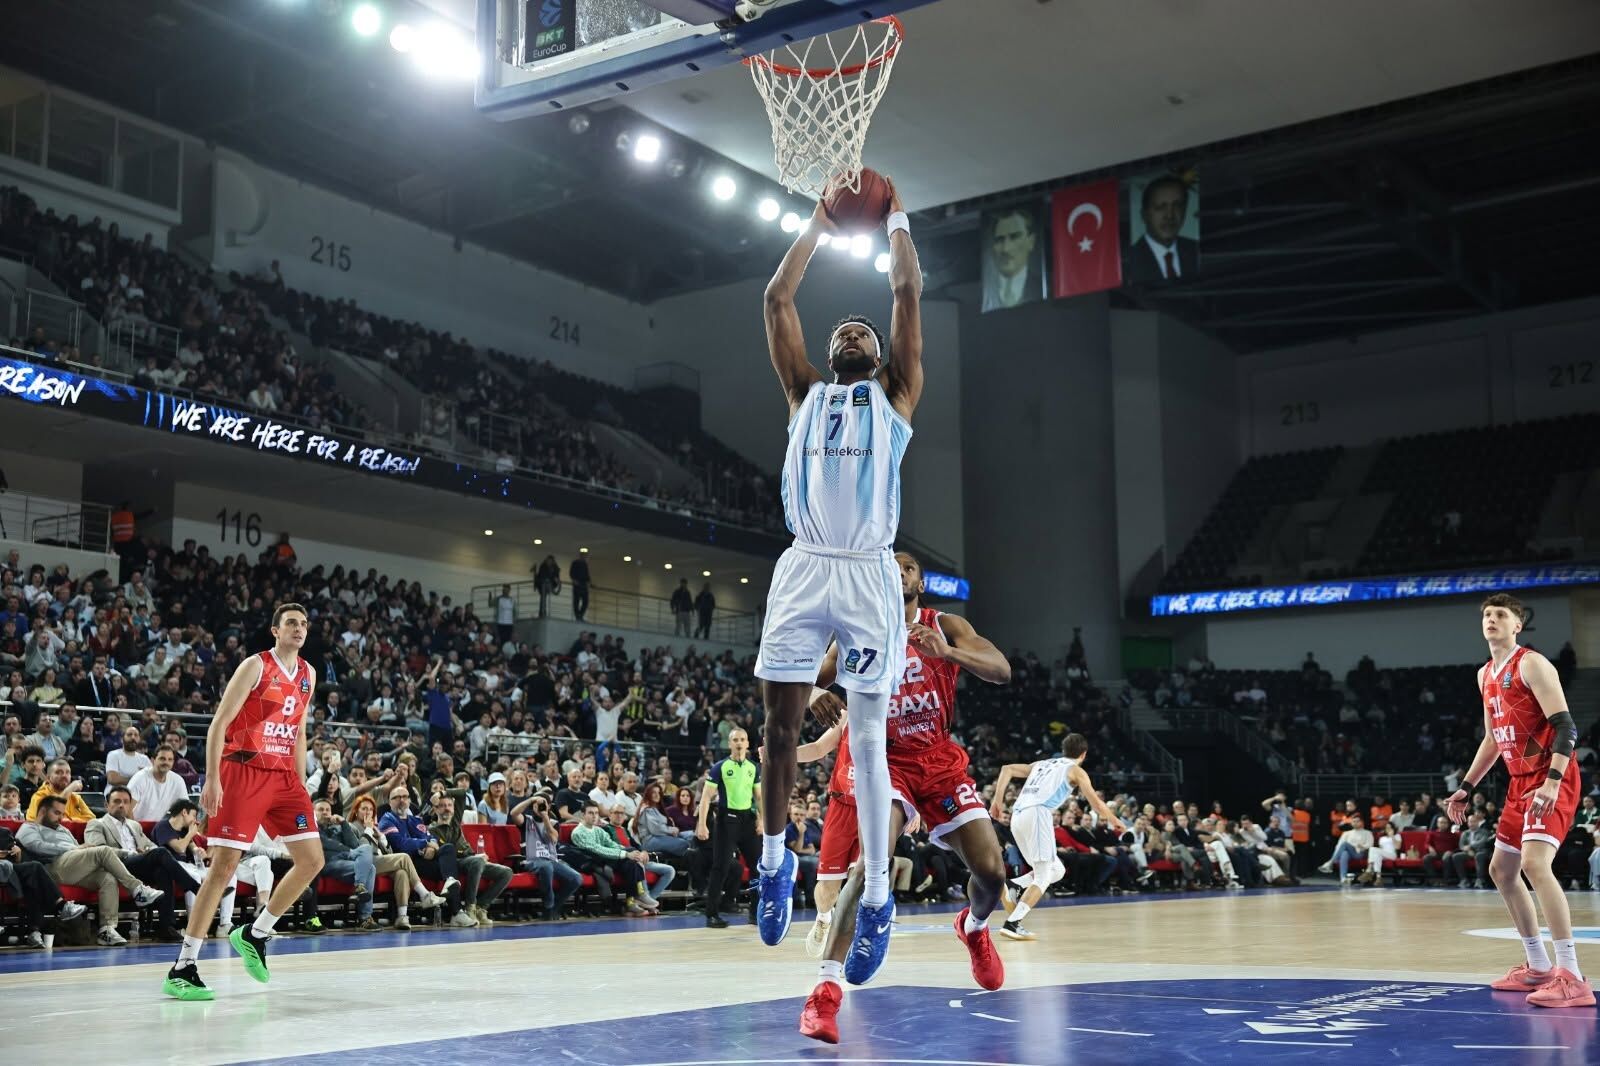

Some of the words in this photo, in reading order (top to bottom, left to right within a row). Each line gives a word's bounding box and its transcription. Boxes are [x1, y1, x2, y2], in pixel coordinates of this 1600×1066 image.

[533, 43, 567, 58] EuroCup
[311, 235, 352, 272] 215
[550, 315, 580, 347] 214
[0, 366, 86, 406] REASON
[828, 413, 842, 440] 7
[1280, 402, 1320, 426] 213
[172, 403, 207, 431] WE
[209, 415, 250, 441] ARE
[251, 420, 304, 452] HERE
[306, 435, 339, 460] FOR
[343, 444, 356, 463] A
[360, 447, 420, 473] REASON
[823, 446, 873, 457] Telekom
[216, 507, 262, 548] 116
[1168, 594, 1190, 611] WE
[1192, 593, 1219, 611] ARE
[1220, 591, 1257, 610] HERE
[1288, 587, 1298, 602] A
[858, 647, 878, 674] 7
[900, 656, 925, 684] 2
[282, 695, 296, 716] 8
[887, 690, 940, 718] BAXI
[898, 721, 936, 737] MANRESA
